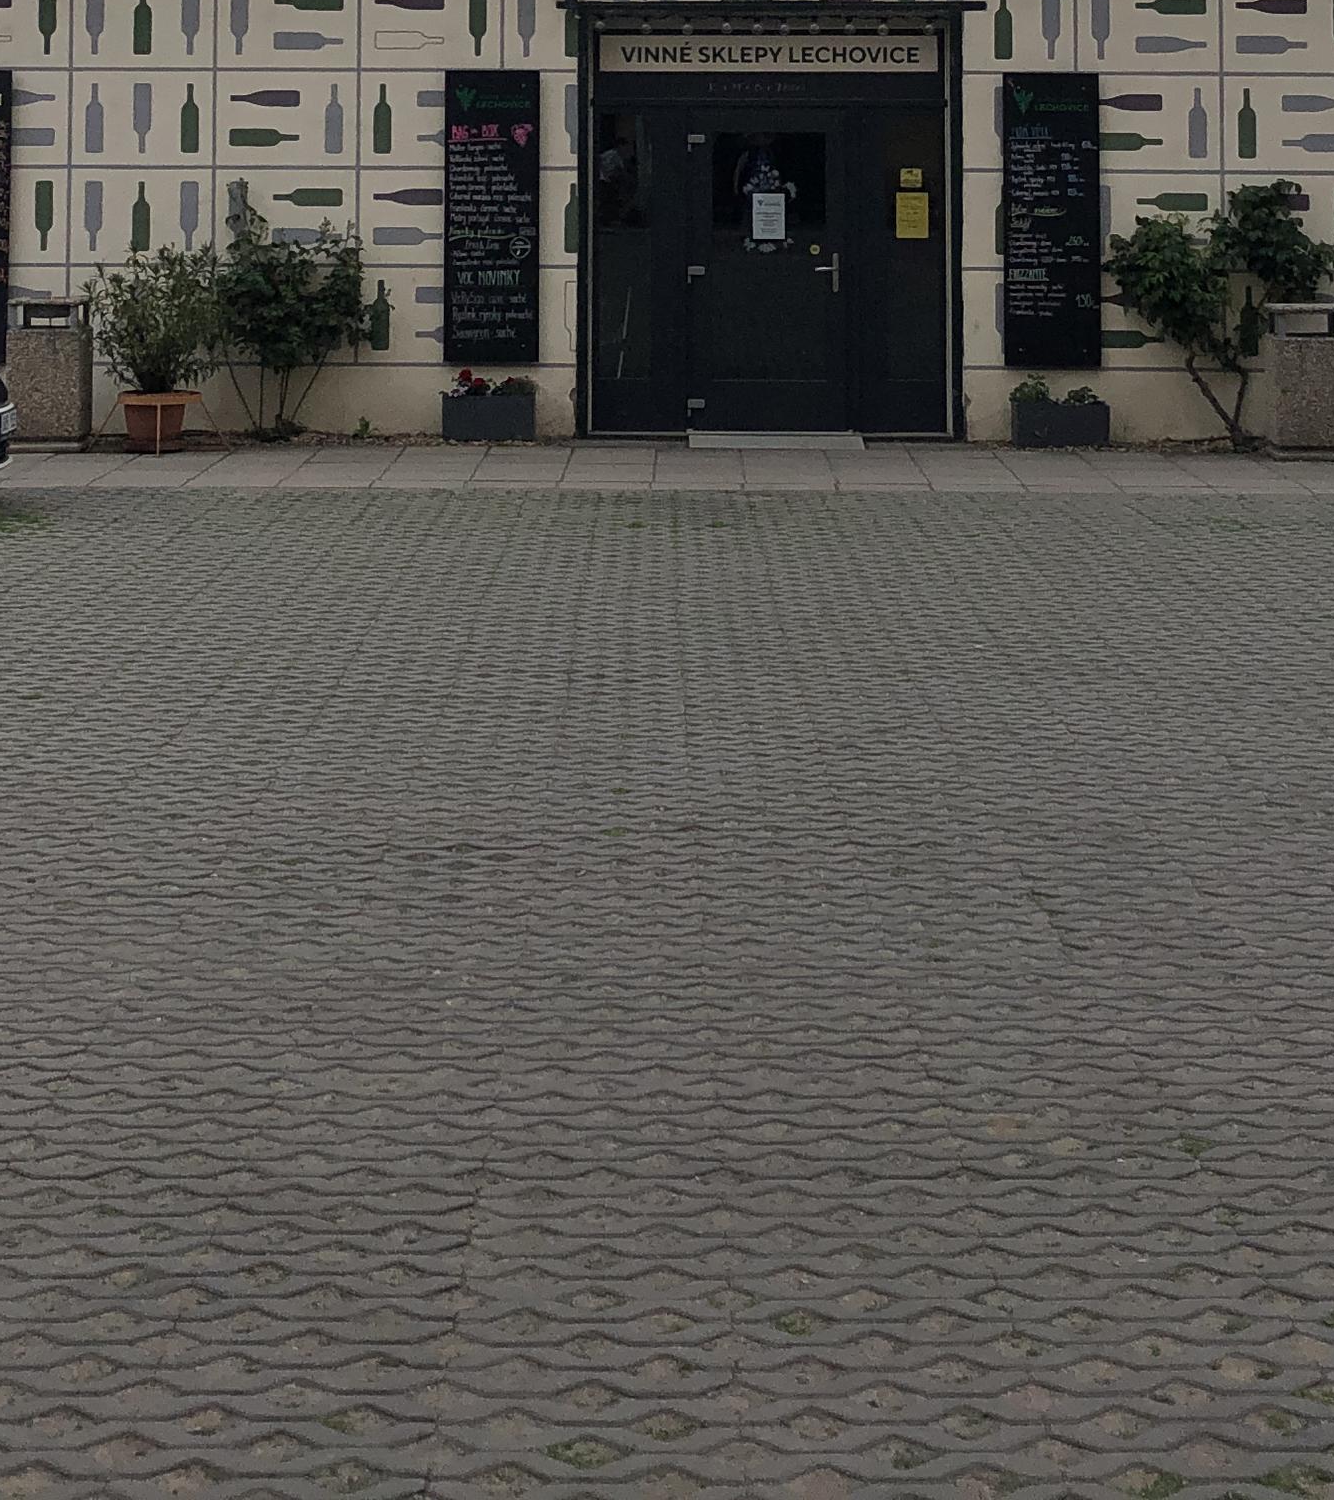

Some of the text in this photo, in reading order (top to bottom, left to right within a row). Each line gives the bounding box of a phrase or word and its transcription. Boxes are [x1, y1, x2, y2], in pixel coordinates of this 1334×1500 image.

[621, 41, 920, 64] VINNÉ SKLEPY LECHOVICE
